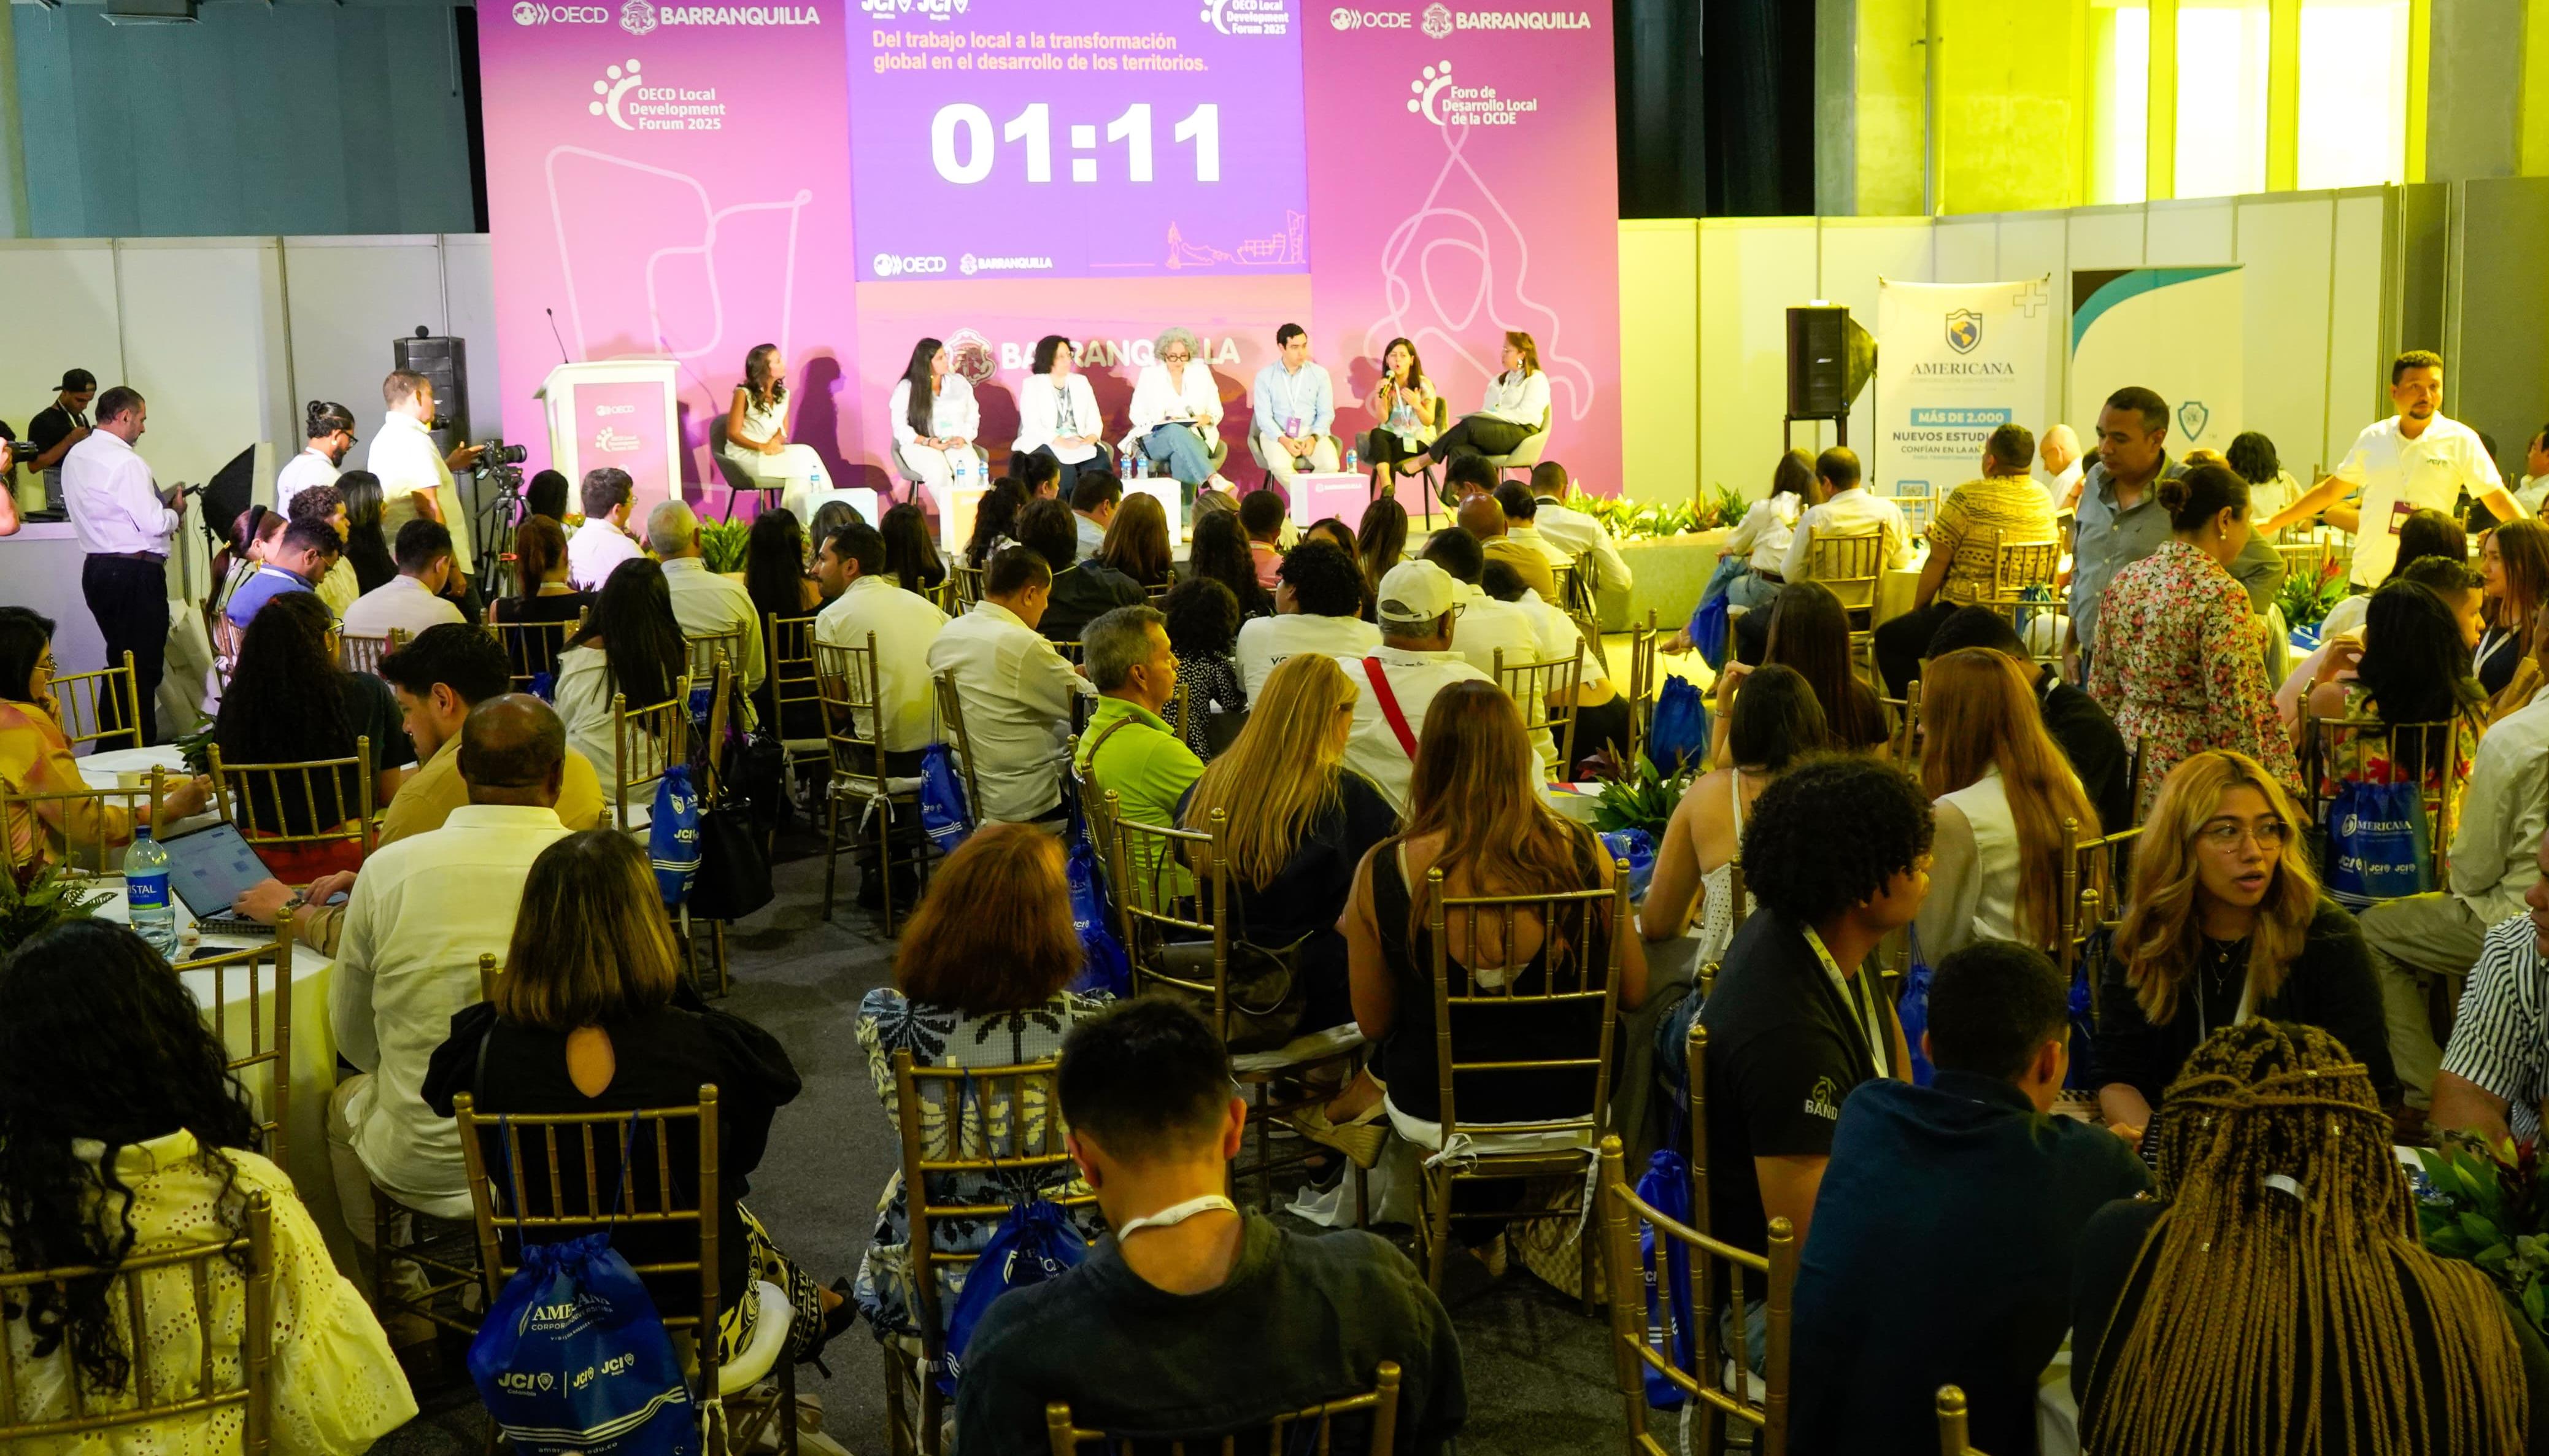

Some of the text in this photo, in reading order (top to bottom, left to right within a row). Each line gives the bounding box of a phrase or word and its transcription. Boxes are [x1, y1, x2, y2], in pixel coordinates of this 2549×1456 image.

[552, 6, 820, 26] OECD BARRANQUILLA
[1226, 11, 1289, 24] Development
[1363, 12, 1591, 30] OCDE BARRANQUILLA
[1232, 23, 1262, 34] Forum
[873, 30, 1177, 52] Del trabajo local a la transformación
[874, 52, 1208, 74] global en el desarrollo de los territorios.
[638, 88, 716, 101] OECD Local
[1451, 86, 1496, 99] Foro de
[630, 102, 726, 117] Development
[1442, 99, 1537, 112] Desarrollo Local
[639, 118, 722, 130] Forum 2025
[1451, 112, 1516, 125] de la OCDE
[931, 102, 1221, 184] 01:11
[903, 256, 1054, 272] OECD BARRANQUILLA
[1001, 339, 1240, 369] BARANQLA
[1911, 363, 2015, 375] AMERICANA
[1918, 410, 2005, 423] MÁS DE 2.000
[1892, 431, 1989, 442] NUEVOS ESTUDI
[1901, 445, 1940, 454] CONFÍAN
[129, 885, 157, 894] ISTAL
[1805, 1099, 1838, 1120] BAND
[1646, 1271, 1657, 1282] CI
[601, 1357, 624, 1374] JCI
[498, 1372, 534, 1390] JCI
[573, 1370, 587, 1387] JCI
